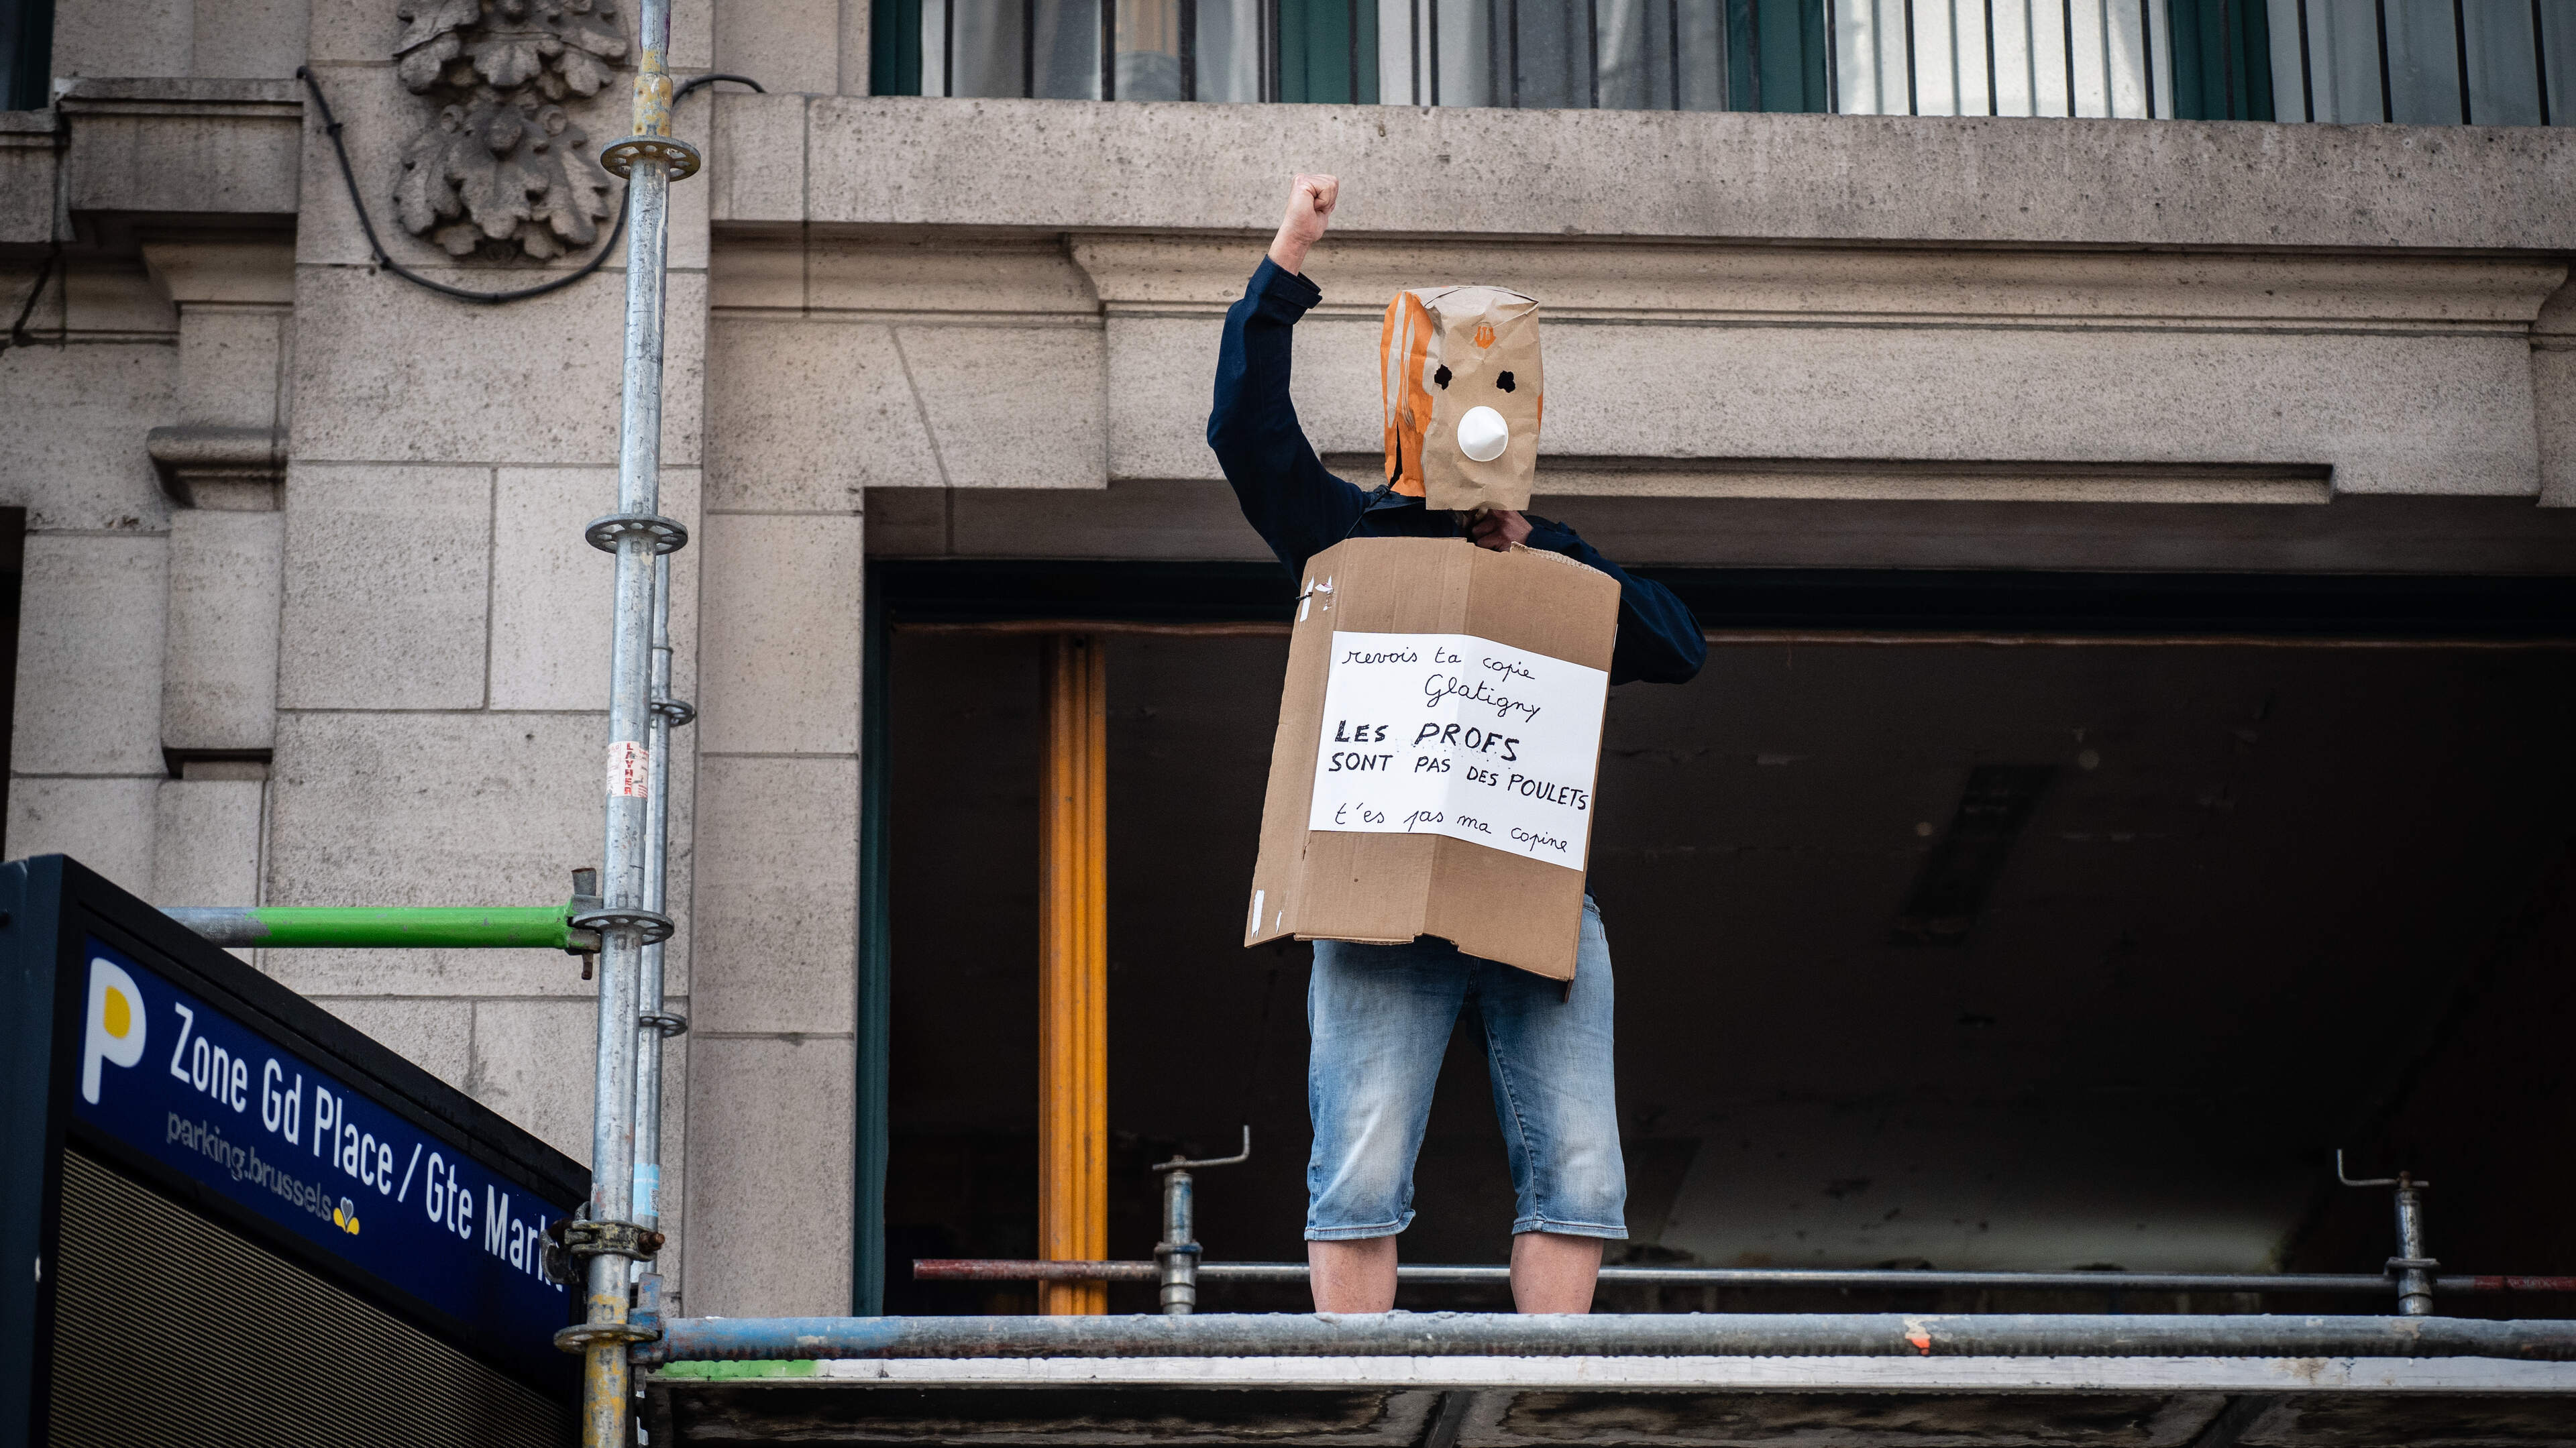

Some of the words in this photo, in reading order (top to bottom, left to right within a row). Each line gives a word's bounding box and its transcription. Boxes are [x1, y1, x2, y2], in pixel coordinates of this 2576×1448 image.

[1342, 647, 1417, 665] revois
[1434, 647, 1462, 663] ta
[1483, 657, 1536, 683] copie
[1425, 673, 1541, 723] Glatigny
[1334, 720, 1389, 742] LES
[1413, 722, 1520, 762] PROFS
[624, 742, 634, 795] LAYHER
[1328, 752, 1394, 772] SONT
[1414, 755, 1451, 773] PAS
[1466, 765, 1499, 787] DES
[1507, 773, 1589, 810] POULETS
[1335, 802, 1385, 825] t'es
[1403, 810, 1444, 832] pas
[1456, 814, 1493, 834] ma
[1511, 826, 1568, 853] copine
[81, 957, 147, 1105] P
[170, 1002, 248, 1113] Zone
[262, 1058, 302, 1145] Gd
[313, 1085, 393, 1196] Place
[397, 1143, 422, 1203] /
[426, 1152, 473, 1239] Gte
[167, 1111, 331, 1221] parking.brussels
